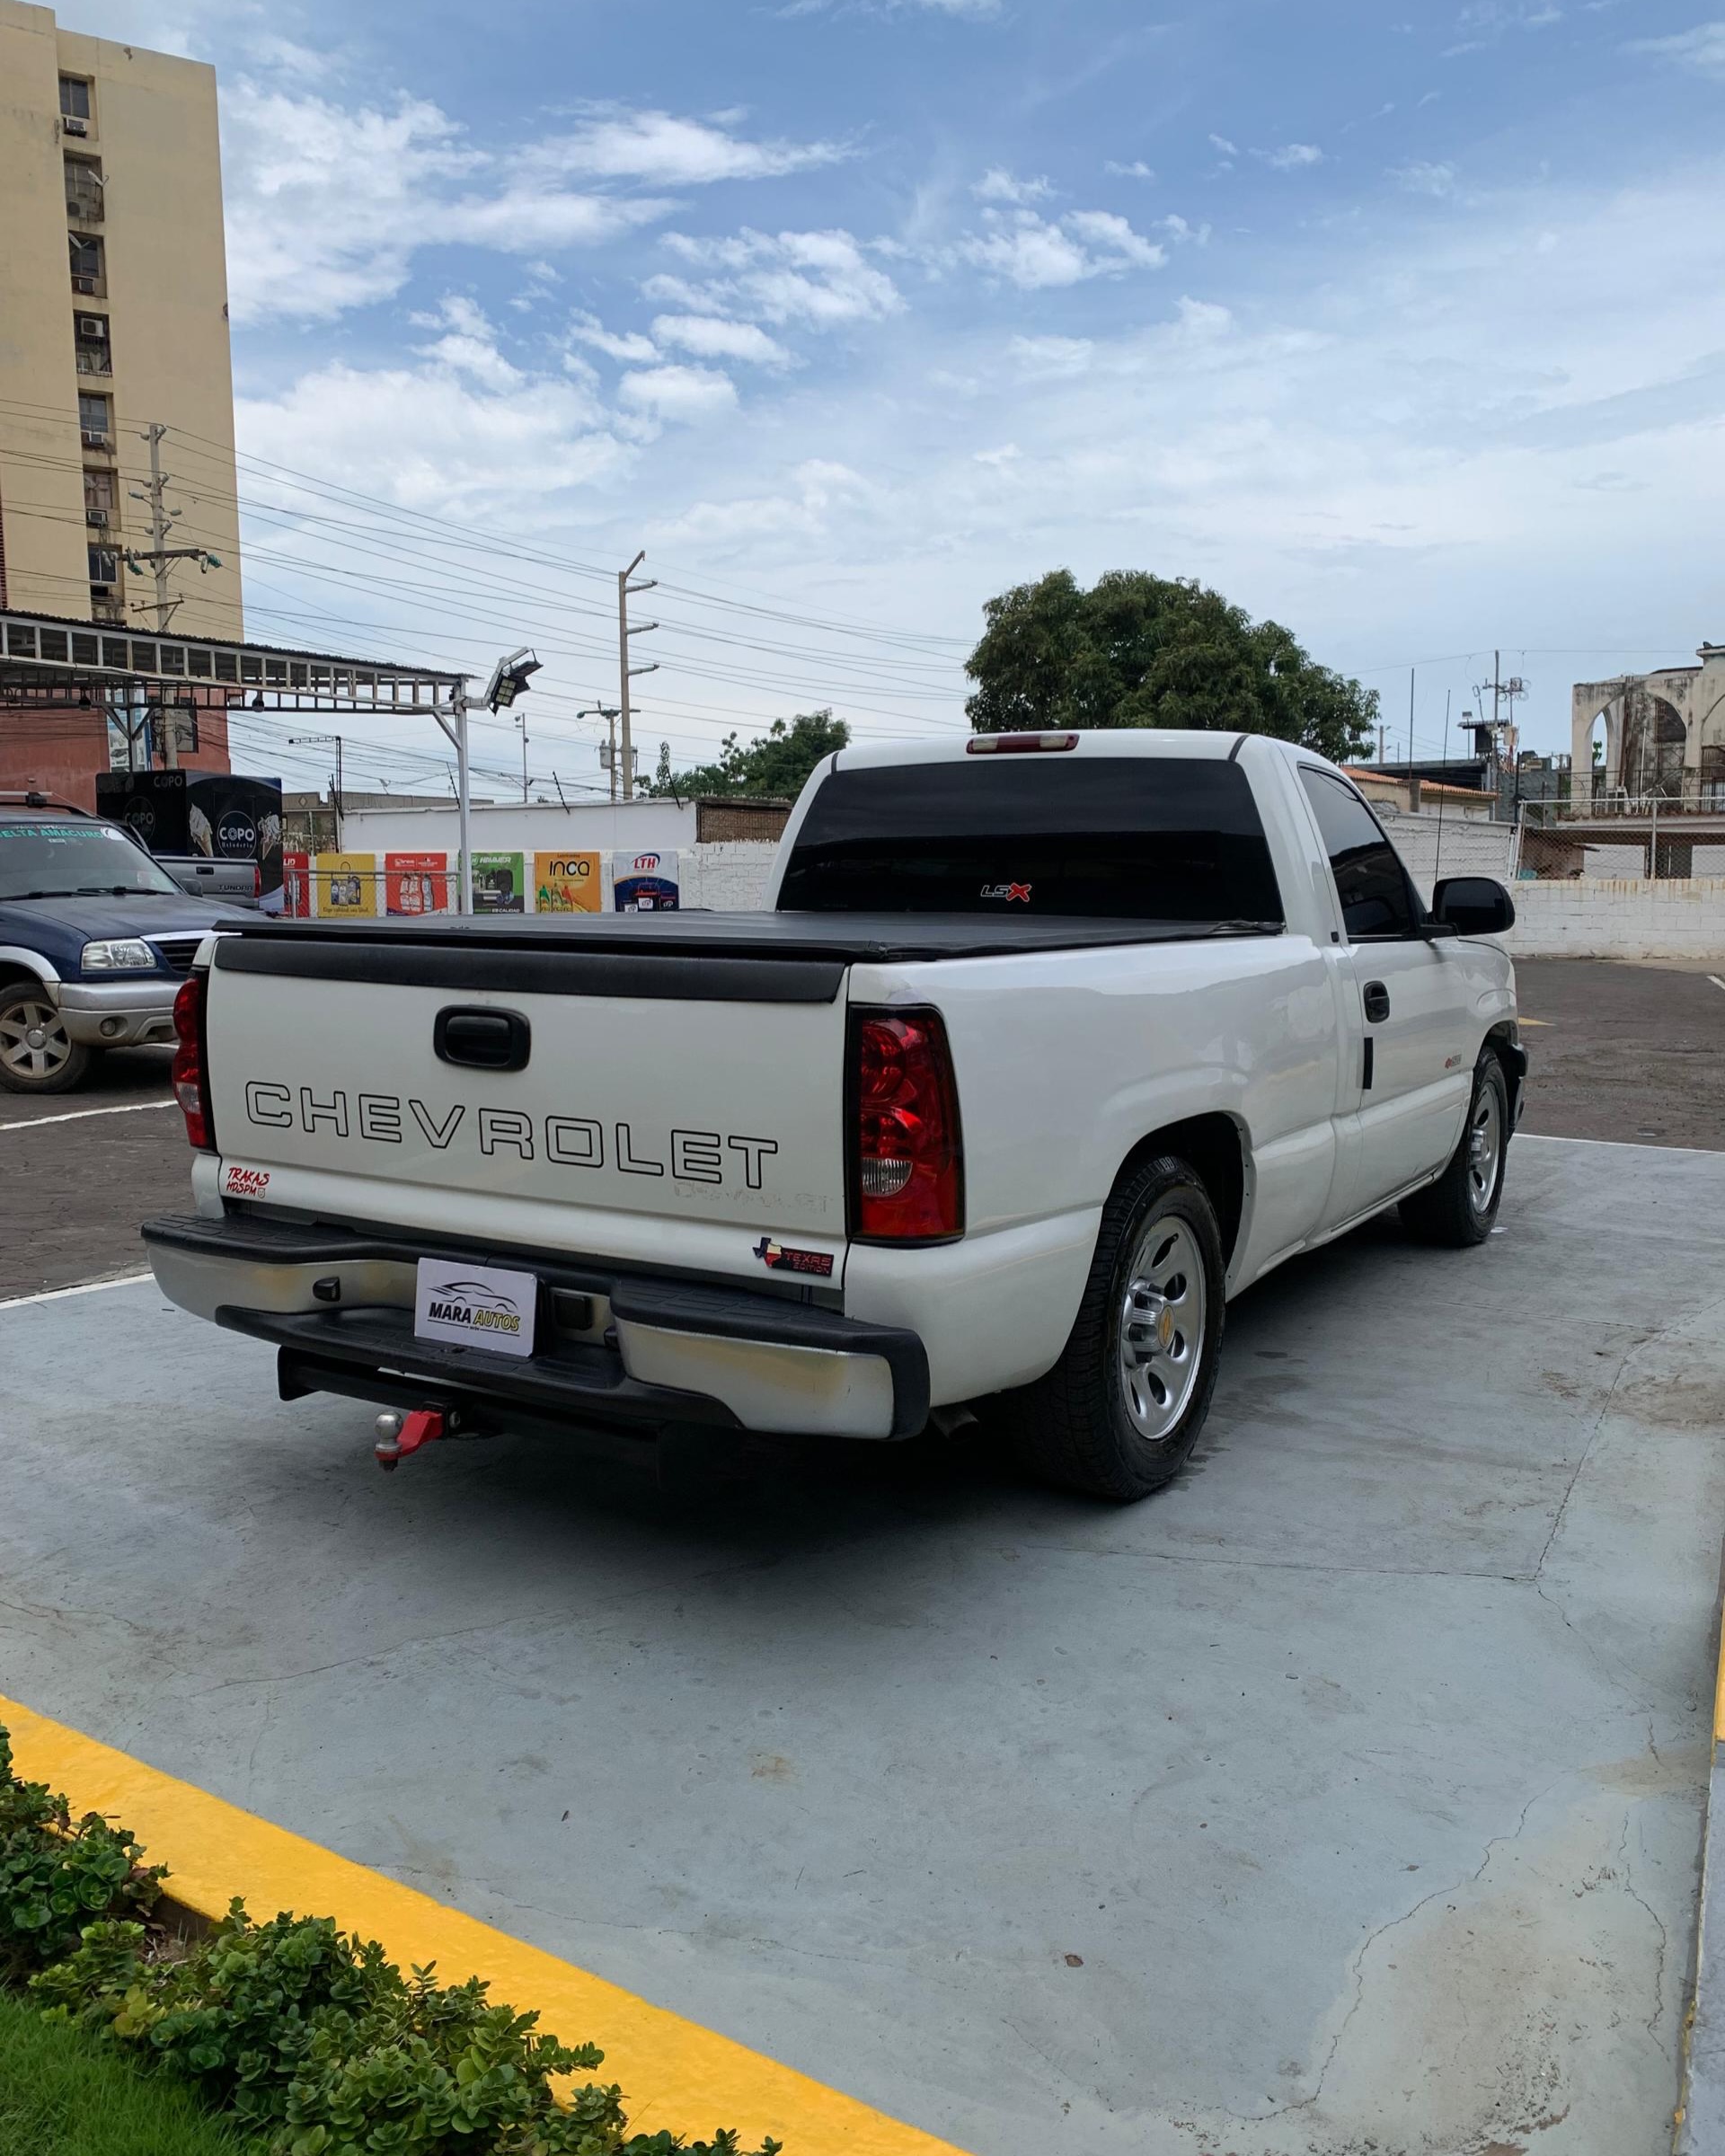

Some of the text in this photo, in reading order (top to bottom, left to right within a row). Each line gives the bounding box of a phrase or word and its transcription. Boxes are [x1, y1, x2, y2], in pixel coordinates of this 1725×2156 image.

[0, 829, 103, 838] ELTA AMACURO
[219, 826, 255, 843] COPO
[634, 858, 656, 869] LTH
[217, 884, 254, 892] TUNDRA
[980, 882, 1032, 903] LSX
[245, 1080, 779, 1190] CHEVROLET
[783, 1250, 832, 1267] TEXAS
[792, 1261, 830, 1275] EDITION
[428, 1302, 521, 1331] MARA AUTOS
